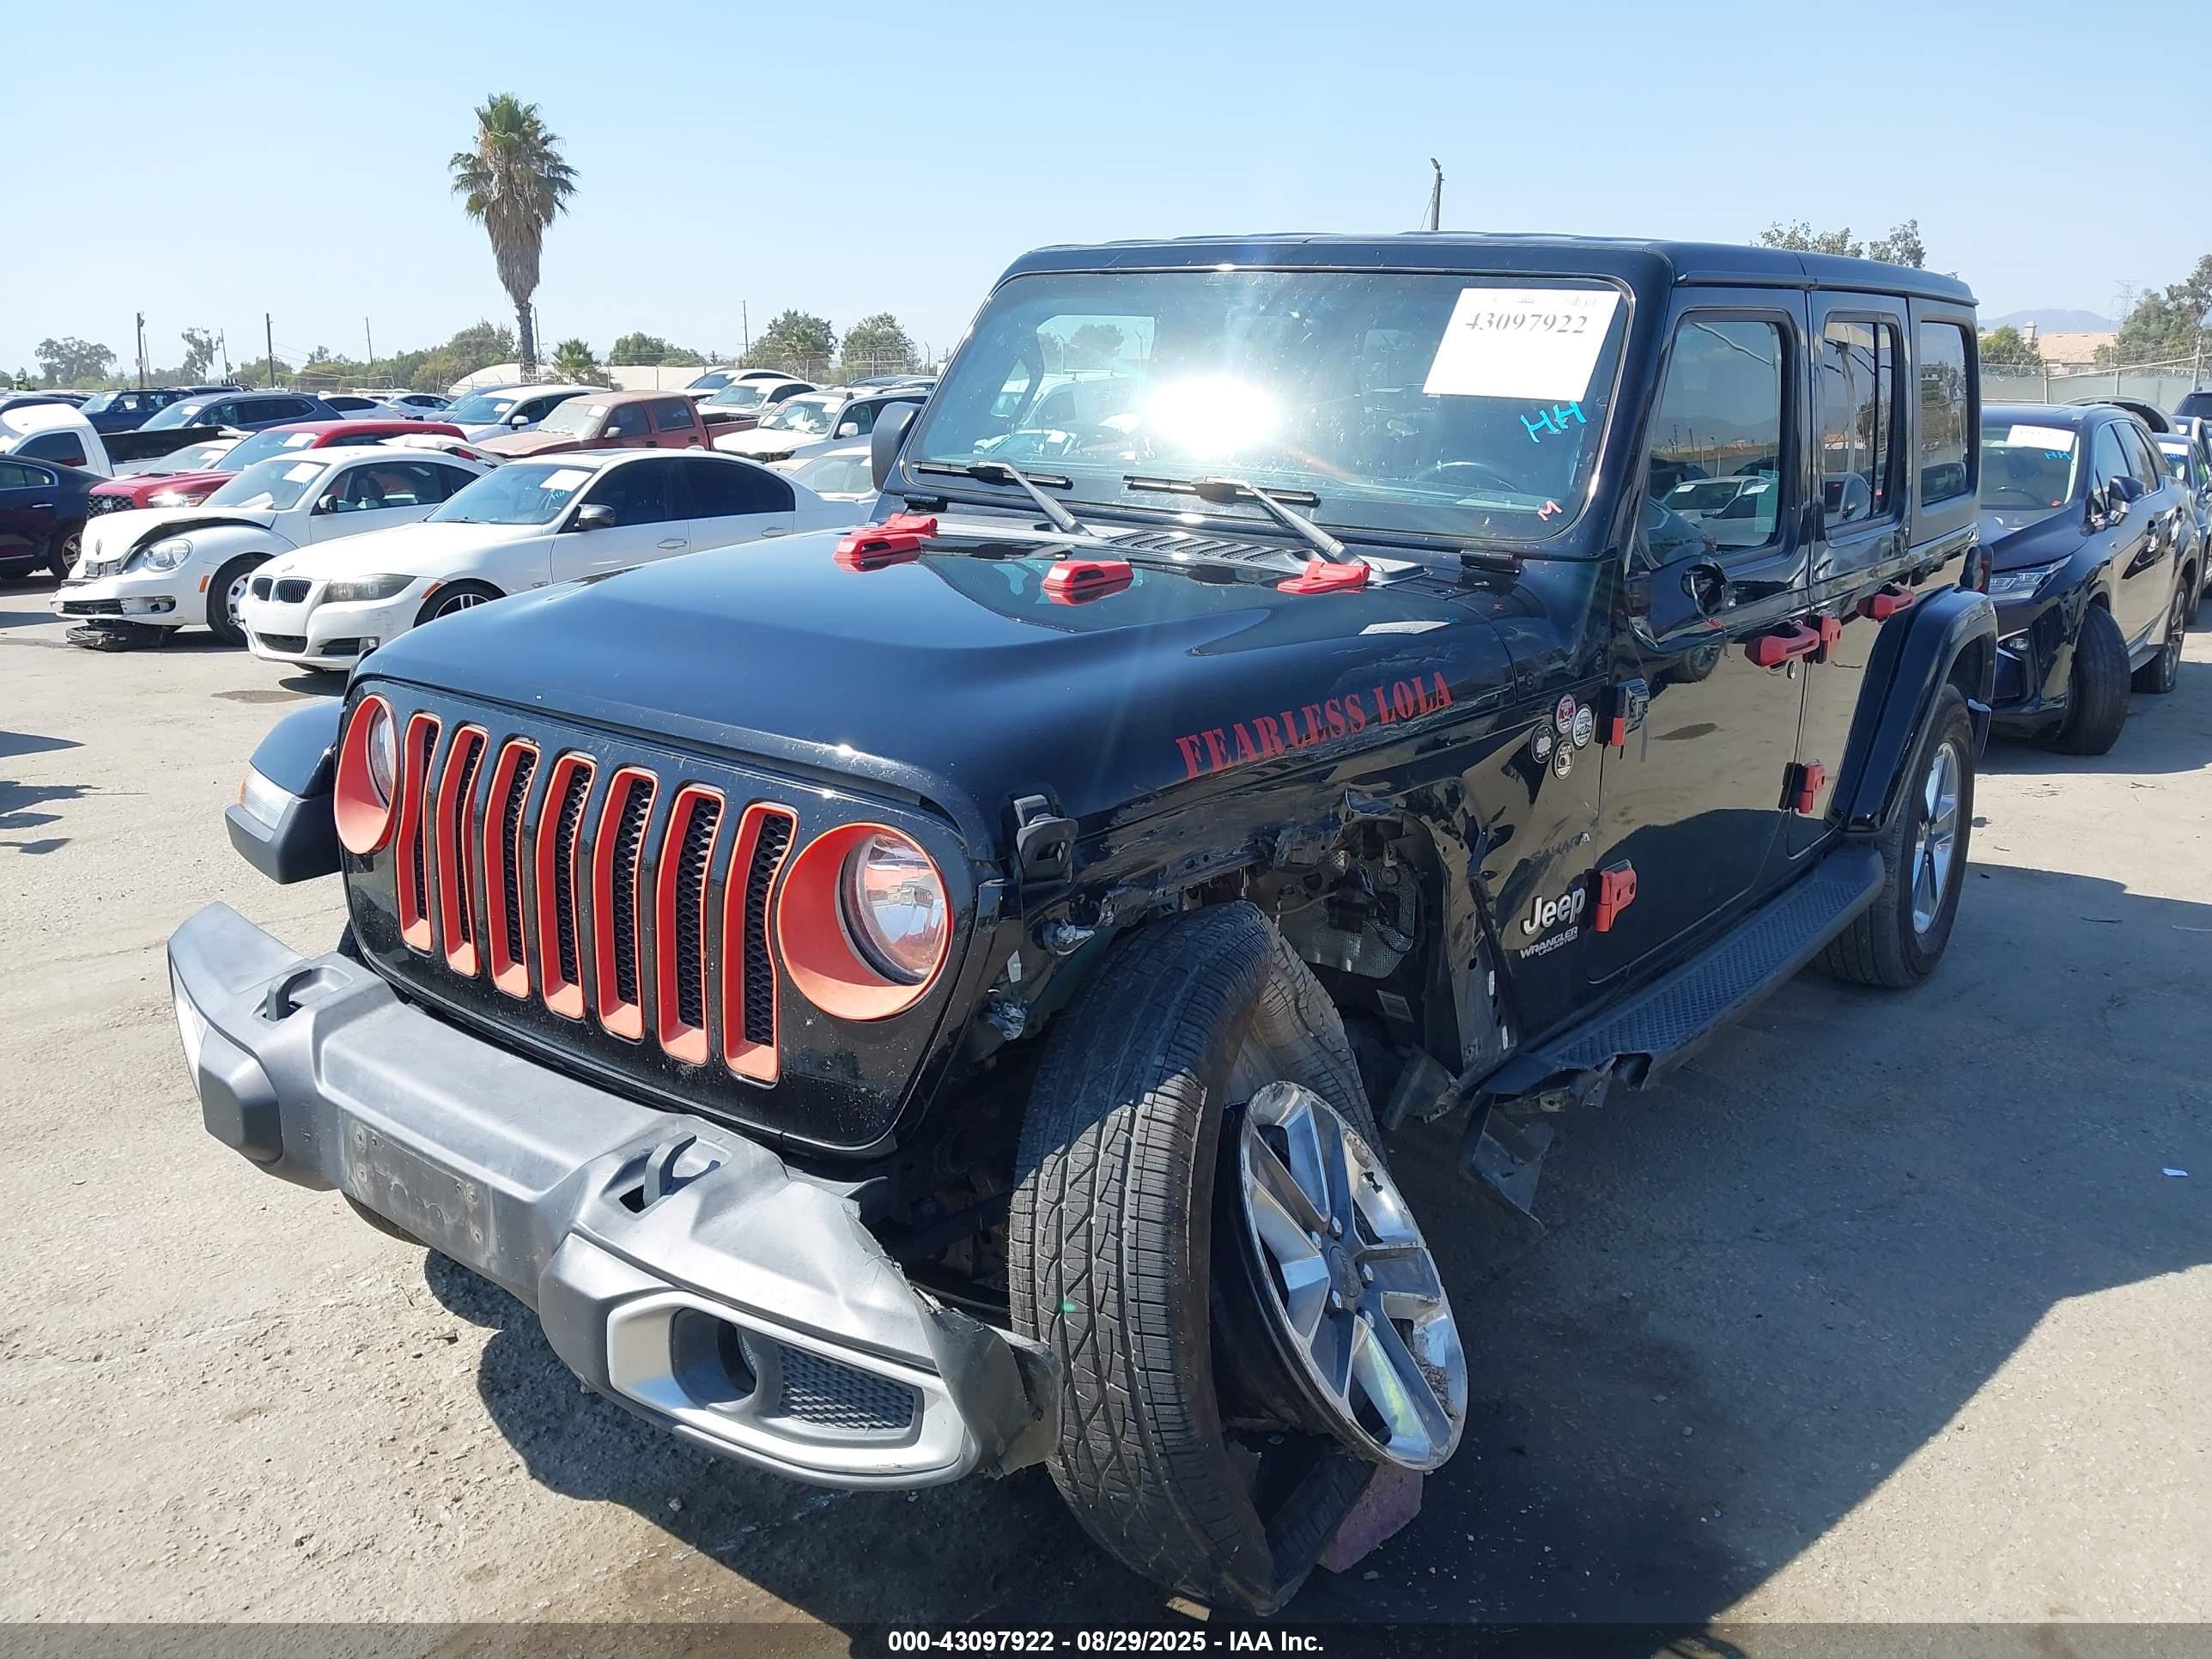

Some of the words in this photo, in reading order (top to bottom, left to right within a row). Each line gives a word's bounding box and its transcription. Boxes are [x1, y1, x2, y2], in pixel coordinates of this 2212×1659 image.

[1466, 312, 1588, 334] 43097922
[1175, 693, 1367, 781] FEARLESS
[1373, 672, 1454, 726] LOLA
[1522, 887, 1586, 935] Jeep
[1520, 926, 1578, 959] WRANGLER
[1538, 933, 1578, 956] UNLIMITED
